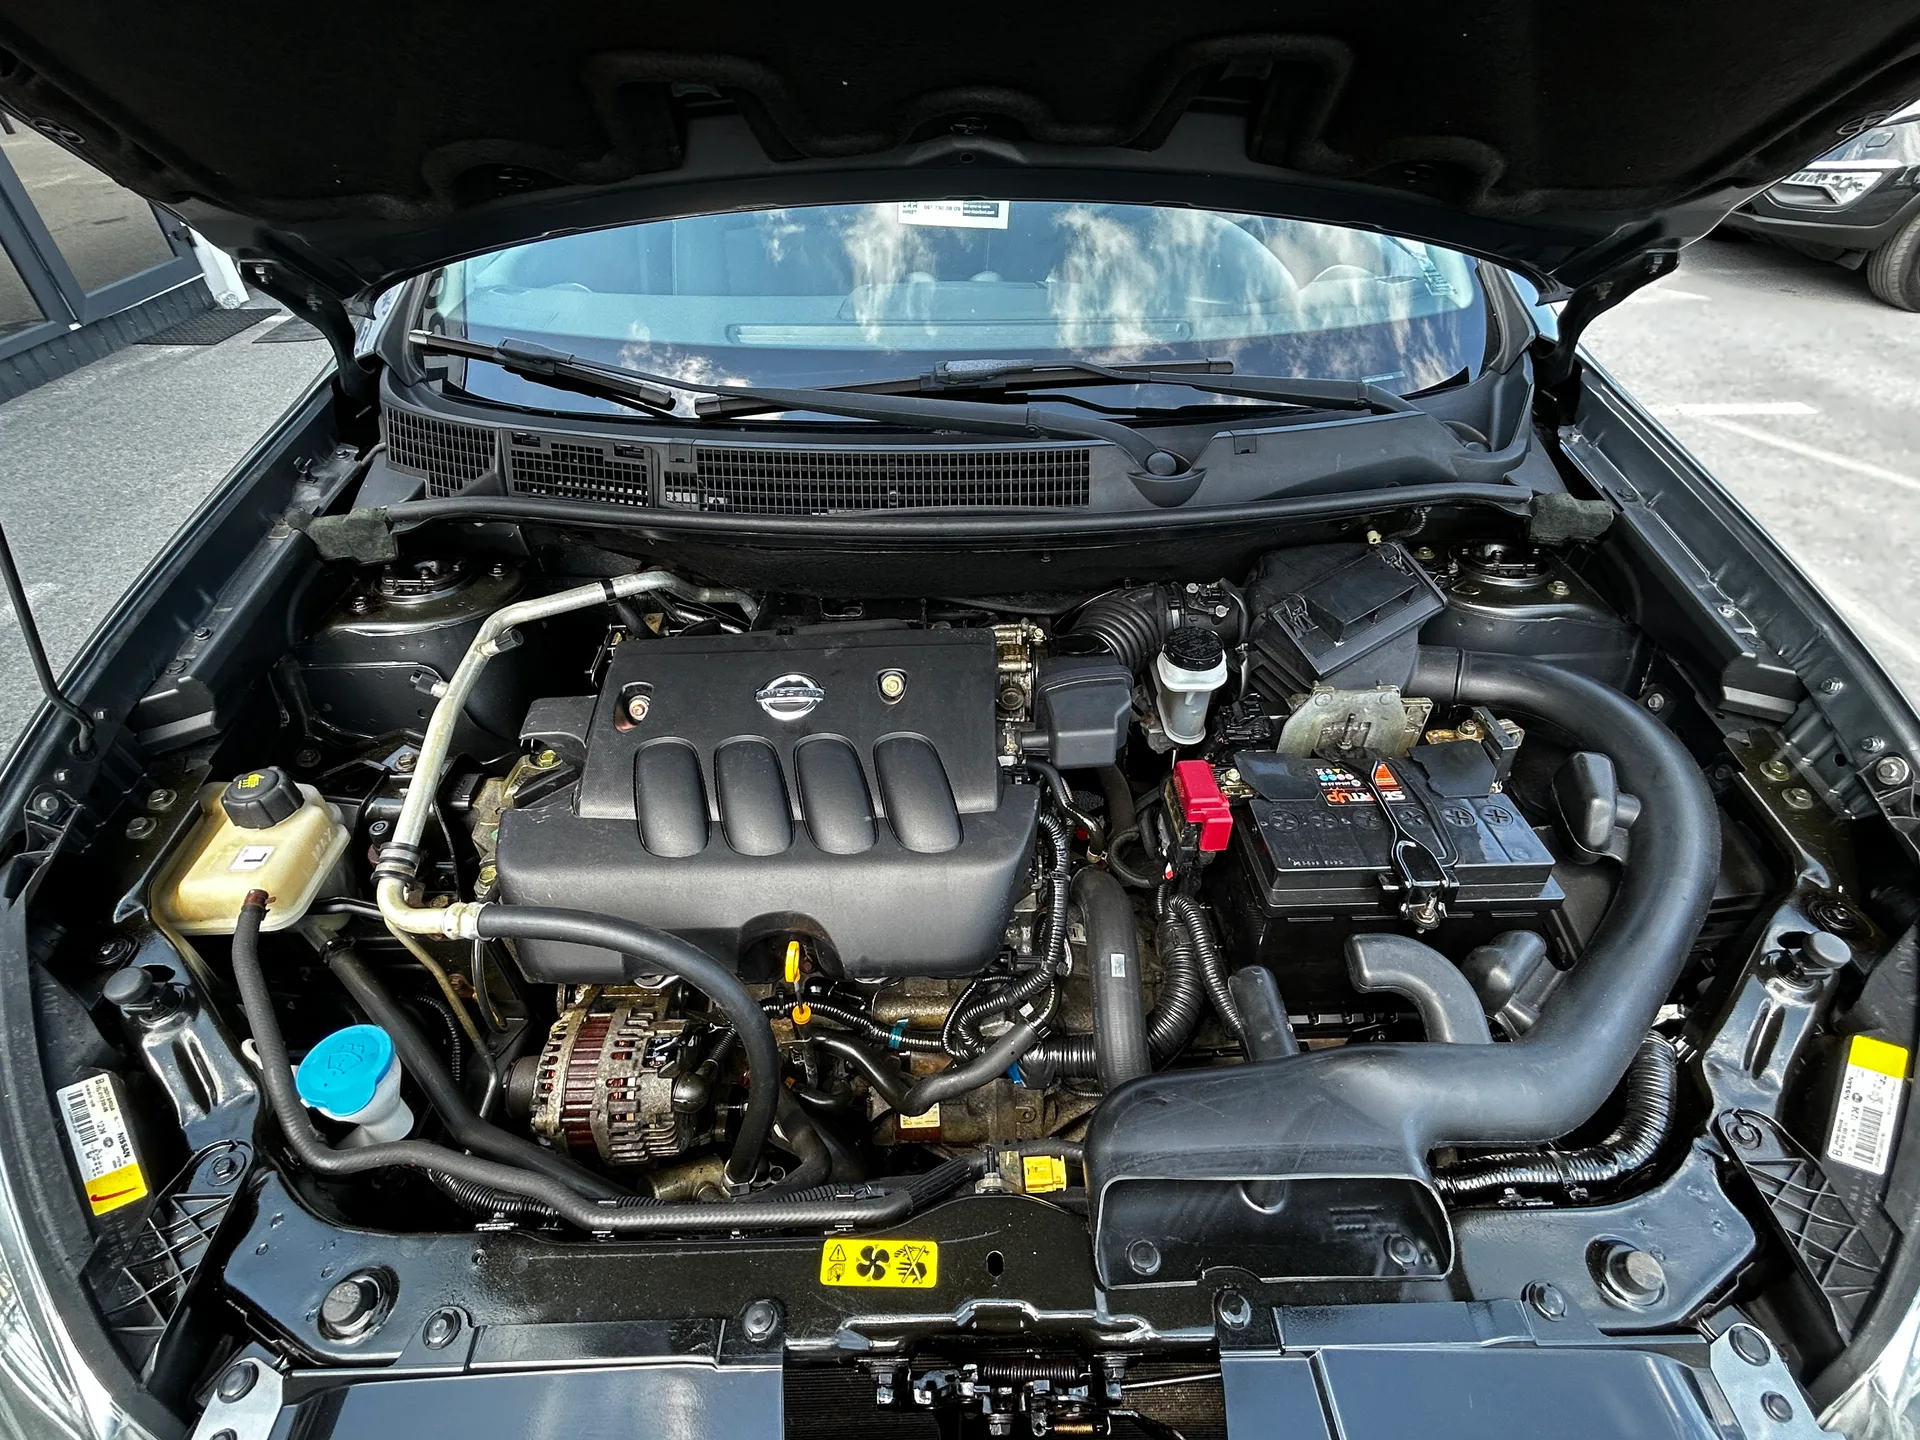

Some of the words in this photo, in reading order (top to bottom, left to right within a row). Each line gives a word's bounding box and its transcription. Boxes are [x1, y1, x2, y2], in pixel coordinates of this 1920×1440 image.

[762, 689, 819, 698] NISSAN
[1843, 1076, 1854, 1100] NISSAN
[116, 1132, 131, 1158] NISSAN
